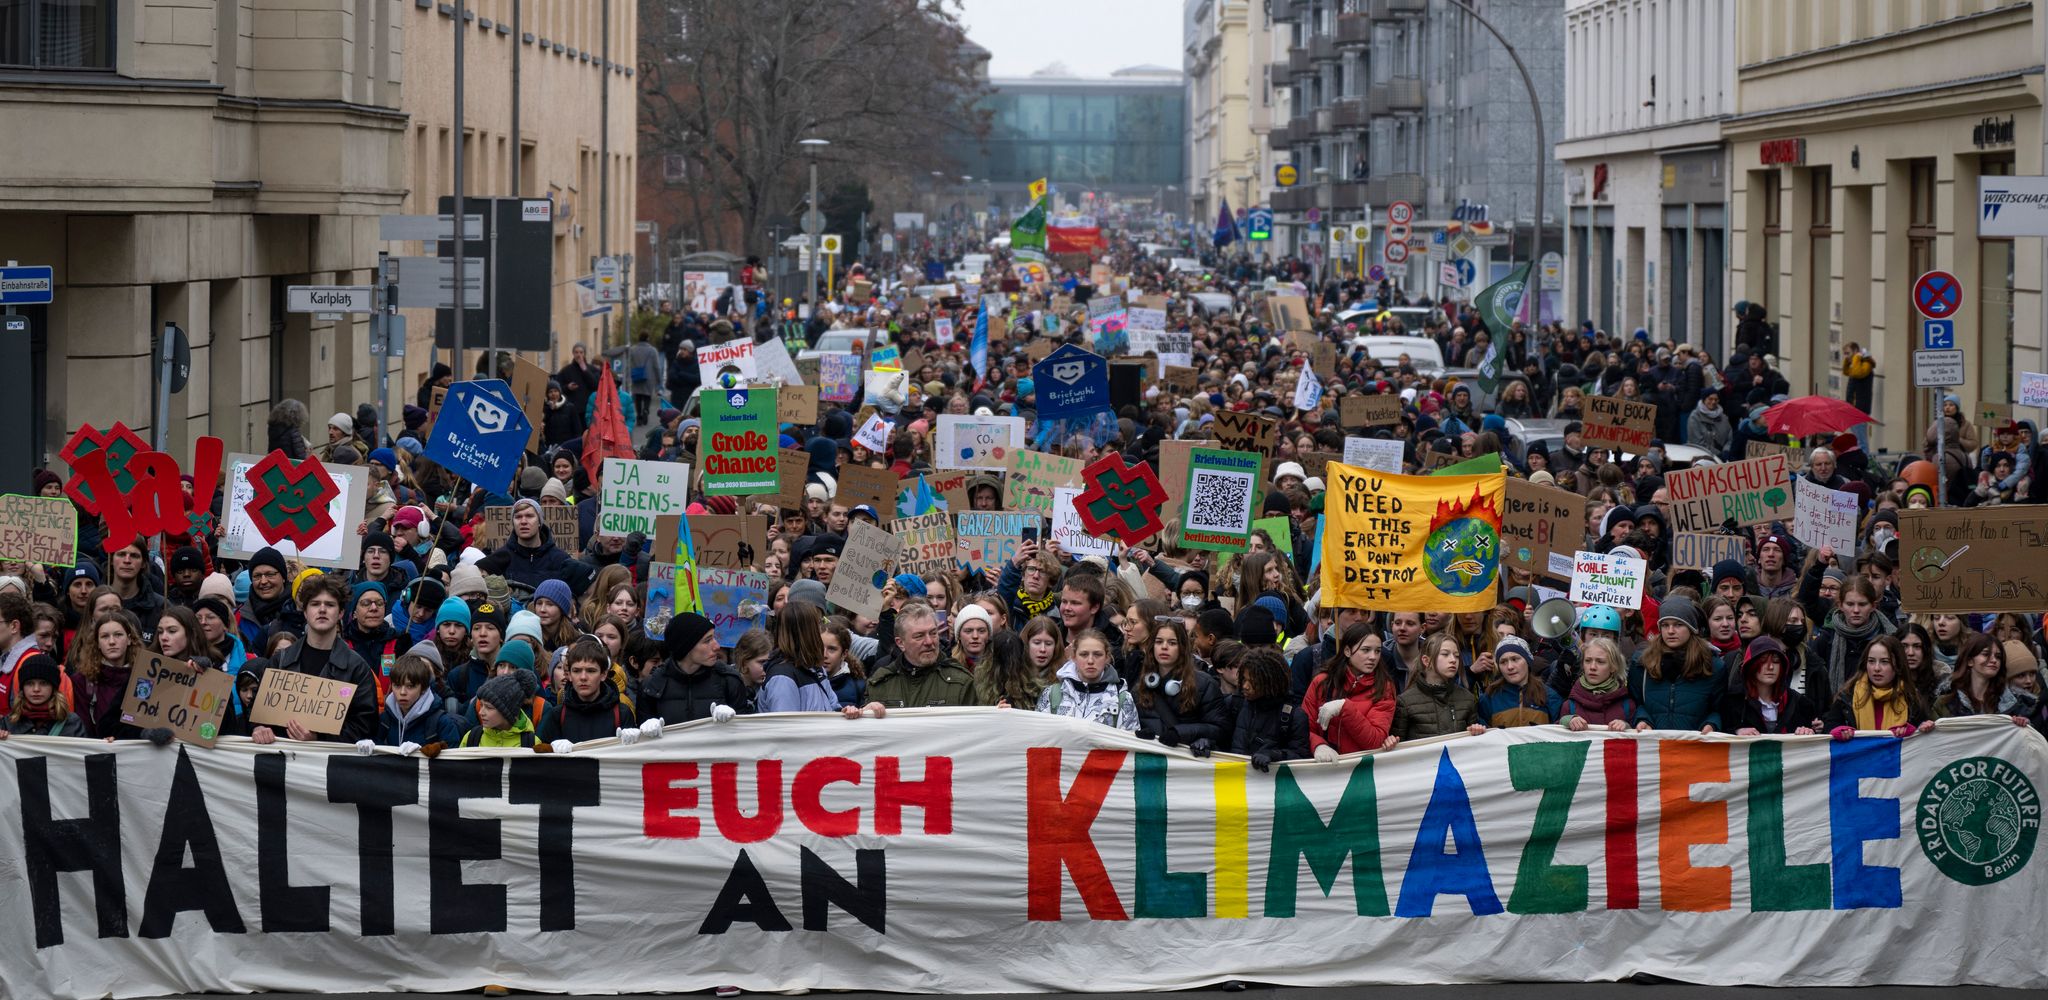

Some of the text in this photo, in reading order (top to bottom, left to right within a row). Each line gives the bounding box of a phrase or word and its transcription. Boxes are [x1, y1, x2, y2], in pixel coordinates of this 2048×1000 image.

[524, 206, 540, 214] ABG
[1394, 207, 1408, 219] 30
[1451, 199, 1486, 221] dm
[1, 280, 48, 290] Einbahnstraße
[310, 291, 351, 306] Karlplatz
[1928, 323, 1945, 345] P
[698, 343, 752, 364] ZUKUNFT
[1624, 403, 1652, 421] BOCK
[712, 431, 768, 452] Große
[705, 454, 776, 475] Chance
[1194, 453, 1258, 470] Briefwahl hier:
[613, 461, 640, 486] JA
[1340, 474, 1383, 492] YOU
[1669, 455, 1790, 502] KLIMASCHUTZ
[7, 496, 65, 515] RESPECT
[604, 489, 680, 512] LEBENS-
[1345, 493, 1402, 514] NEED
[1539, 498, 1549, 514] is
[1554, 505, 1570, 518] no
[922, 512, 947, 528] OUR
[1674, 491, 1765, 533] WEIL BAUM
[1054, 526, 1075, 540] NO
[1369, 517, 1411, 534] THIS
[1900, 516, 1937, 540] The
[4, 530, 57, 550] EXPECT
[1184, 531, 1246, 547] berlin2030.org
[1344, 531, 1405, 550] EARTH,
[847, 548, 880, 571] eure
[900, 548, 919, 562] SO
[922, 542, 953, 560] STOP
[984, 538, 1016, 564] EIS
[1344, 550, 1356, 561] SO
[1674, 535, 1747, 568] GO VEGAN
[948, 556, 958, 569] IT
[1577, 562, 1609, 574] KOHLE
[1345, 566, 1417, 584] DESTROY
[1590, 573, 1638, 590] ZUKUNFT
[1366, 587, 1391, 600] IT
[1950, 576, 1974, 599] the
[1582, 590, 1633, 606] KRAFTWERK
[147, 657, 198, 687] Spread
[268, 671, 335, 698] THERE IS
[189, 690, 228, 719] LOVE
[262, 692, 346, 720] NO PLANET B
[1921, 761, 2039, 861] FRIDAYS FOR FUTURE
[16, 737, 1904, 948] HALTET EUCH KLIMAZIELE
[1984, 853, 2020, 878] Berlin
[699, 849, 887, 934] AN
